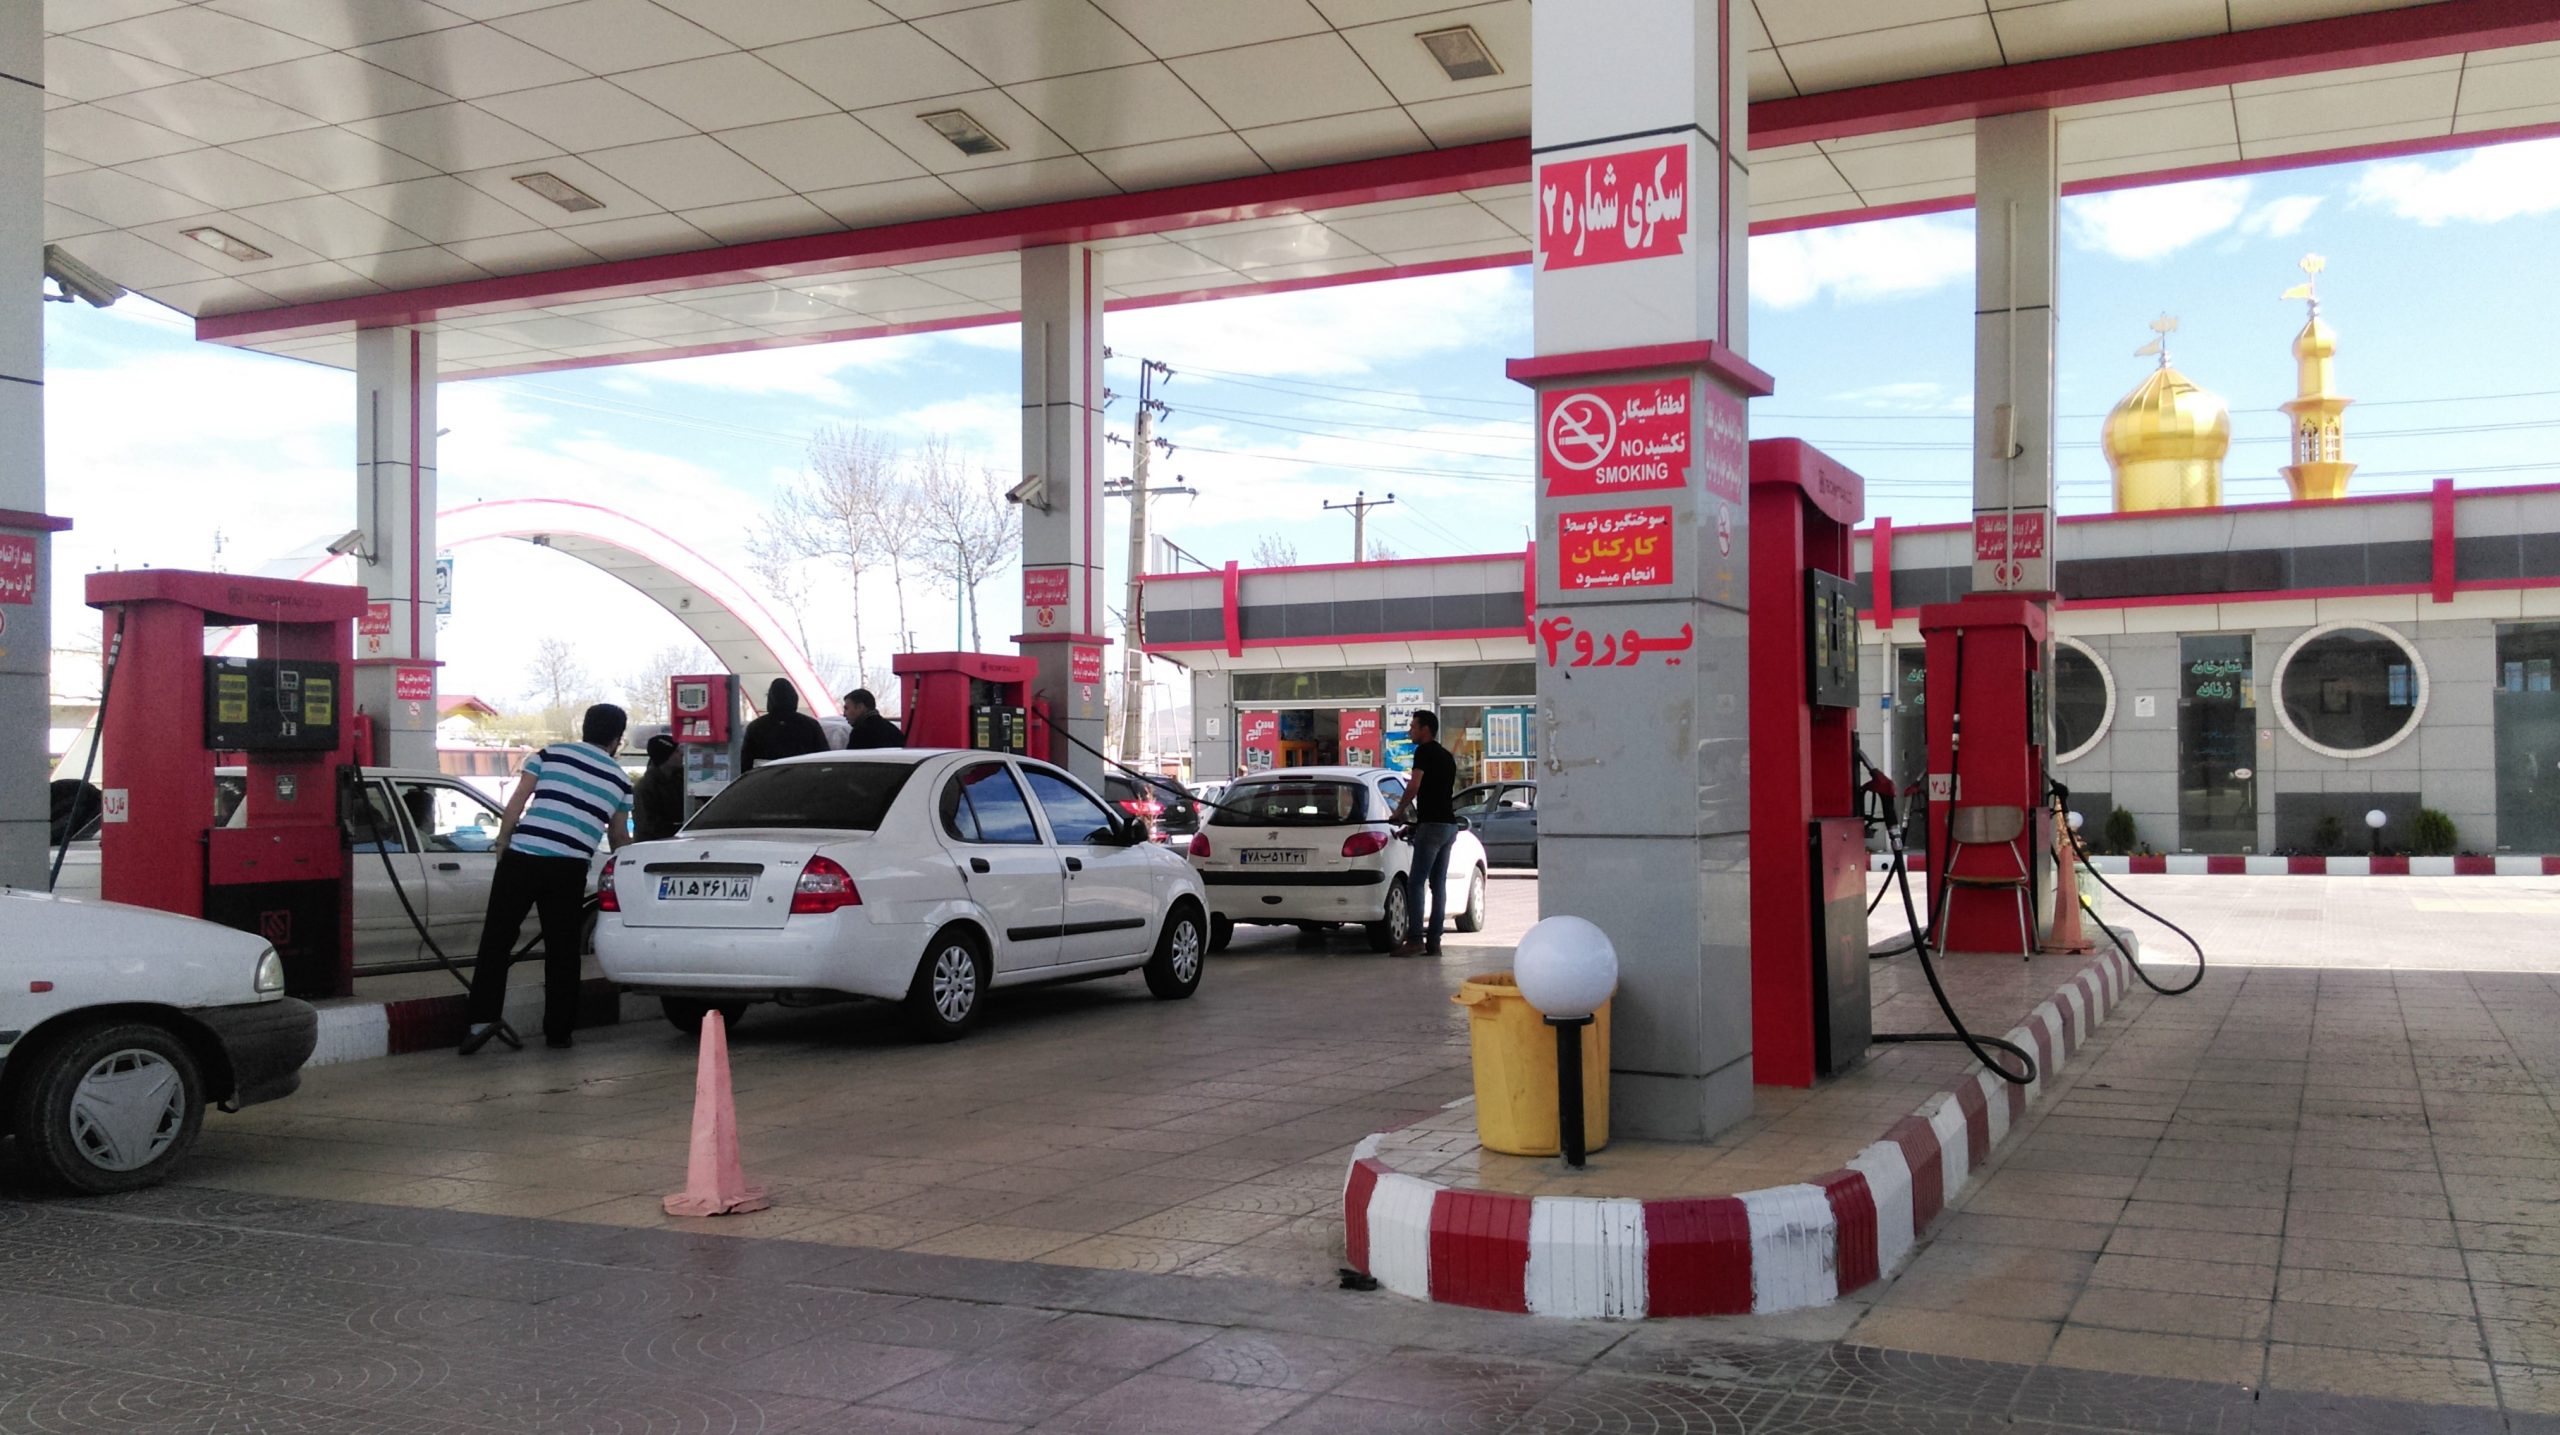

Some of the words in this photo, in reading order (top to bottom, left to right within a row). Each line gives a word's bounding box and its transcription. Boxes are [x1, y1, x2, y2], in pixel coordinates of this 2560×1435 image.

[1563, 163, 1618, 256] شماره
[1623, 153, 1683, 249] سکوی
[1619, 398, 1656, 426] سیگار
[1621, 441, 1643, 456] NO
[1644, 431, 1685, 461] نکشید
[1595, 462, 1669, 484] SMOKING
[1563, 518, 1598, 536] توسط
[1599, 512, 1666, 535] سوختگیری
[1571, 536, 1658, 564] کارکنان
[1576, 569, 1620, 588] میشود
[1622, 567, 1655, 587] انجام
